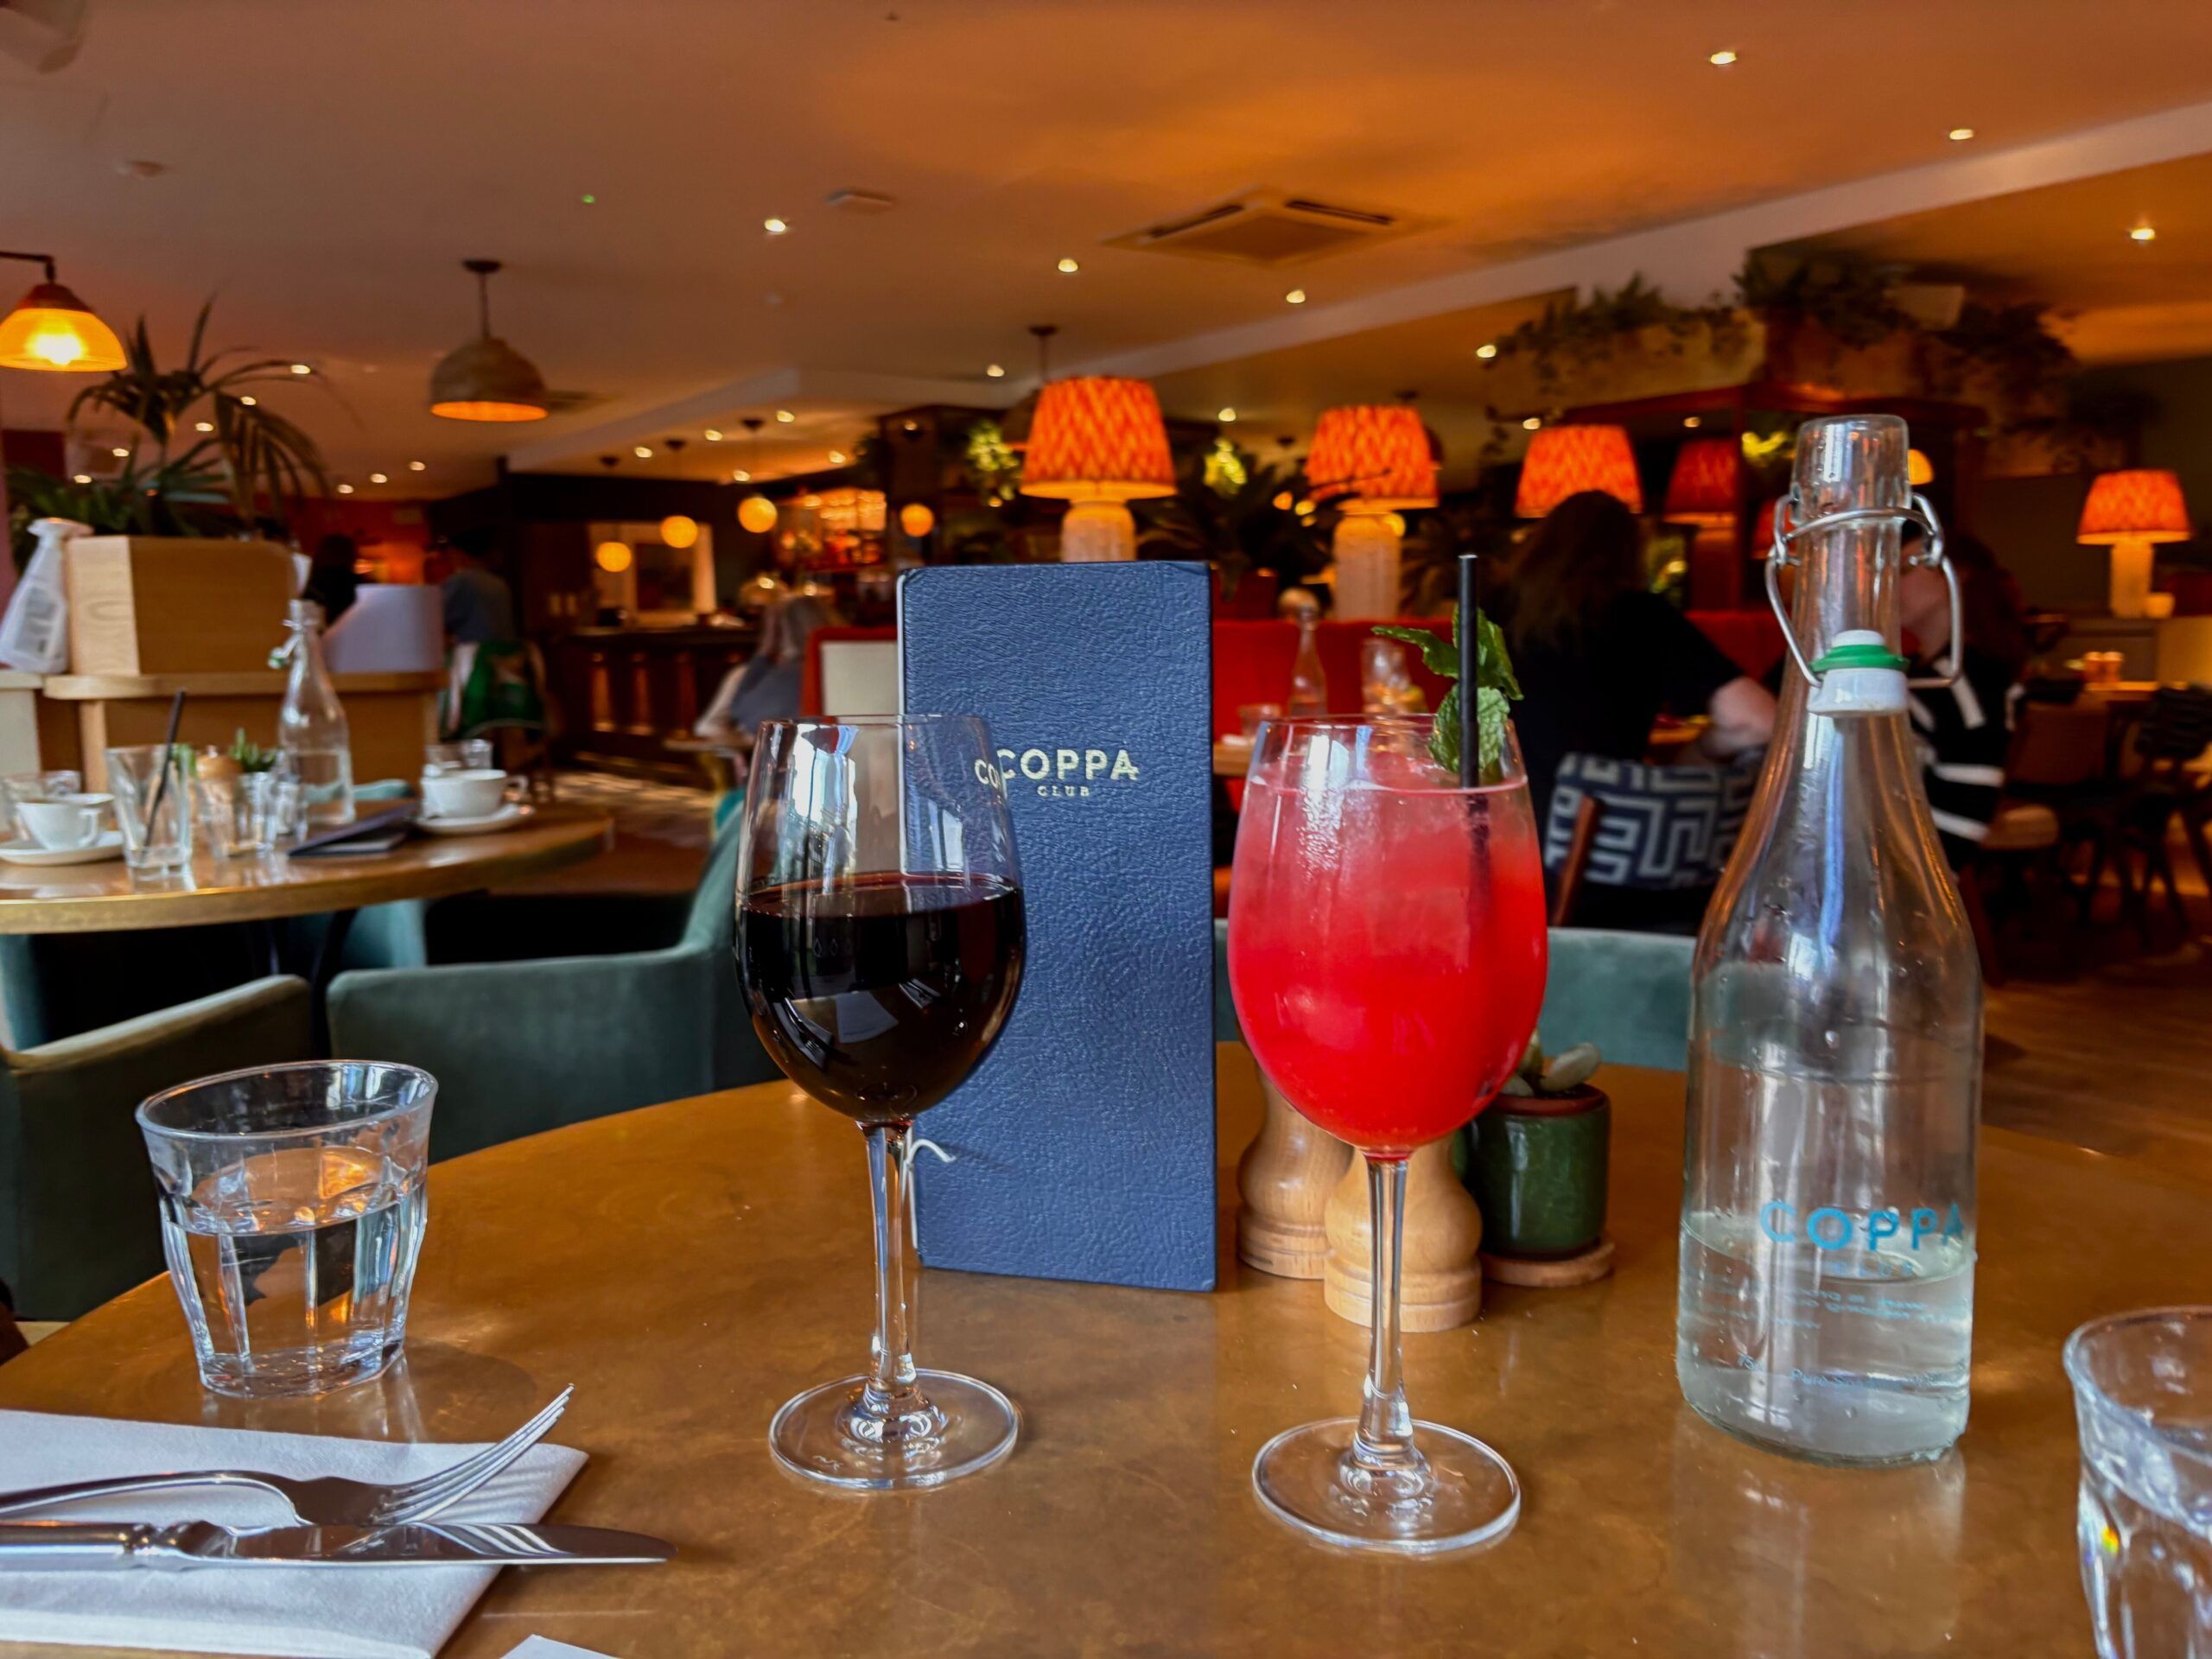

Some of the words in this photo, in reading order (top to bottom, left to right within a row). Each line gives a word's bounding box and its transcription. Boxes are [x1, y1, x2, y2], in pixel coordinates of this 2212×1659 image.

[996, 748, 1140, 781] COPPA
[1037, 785, 1090, 797] CLUB
[1759, 1199, 1965, 1252] COPPA
